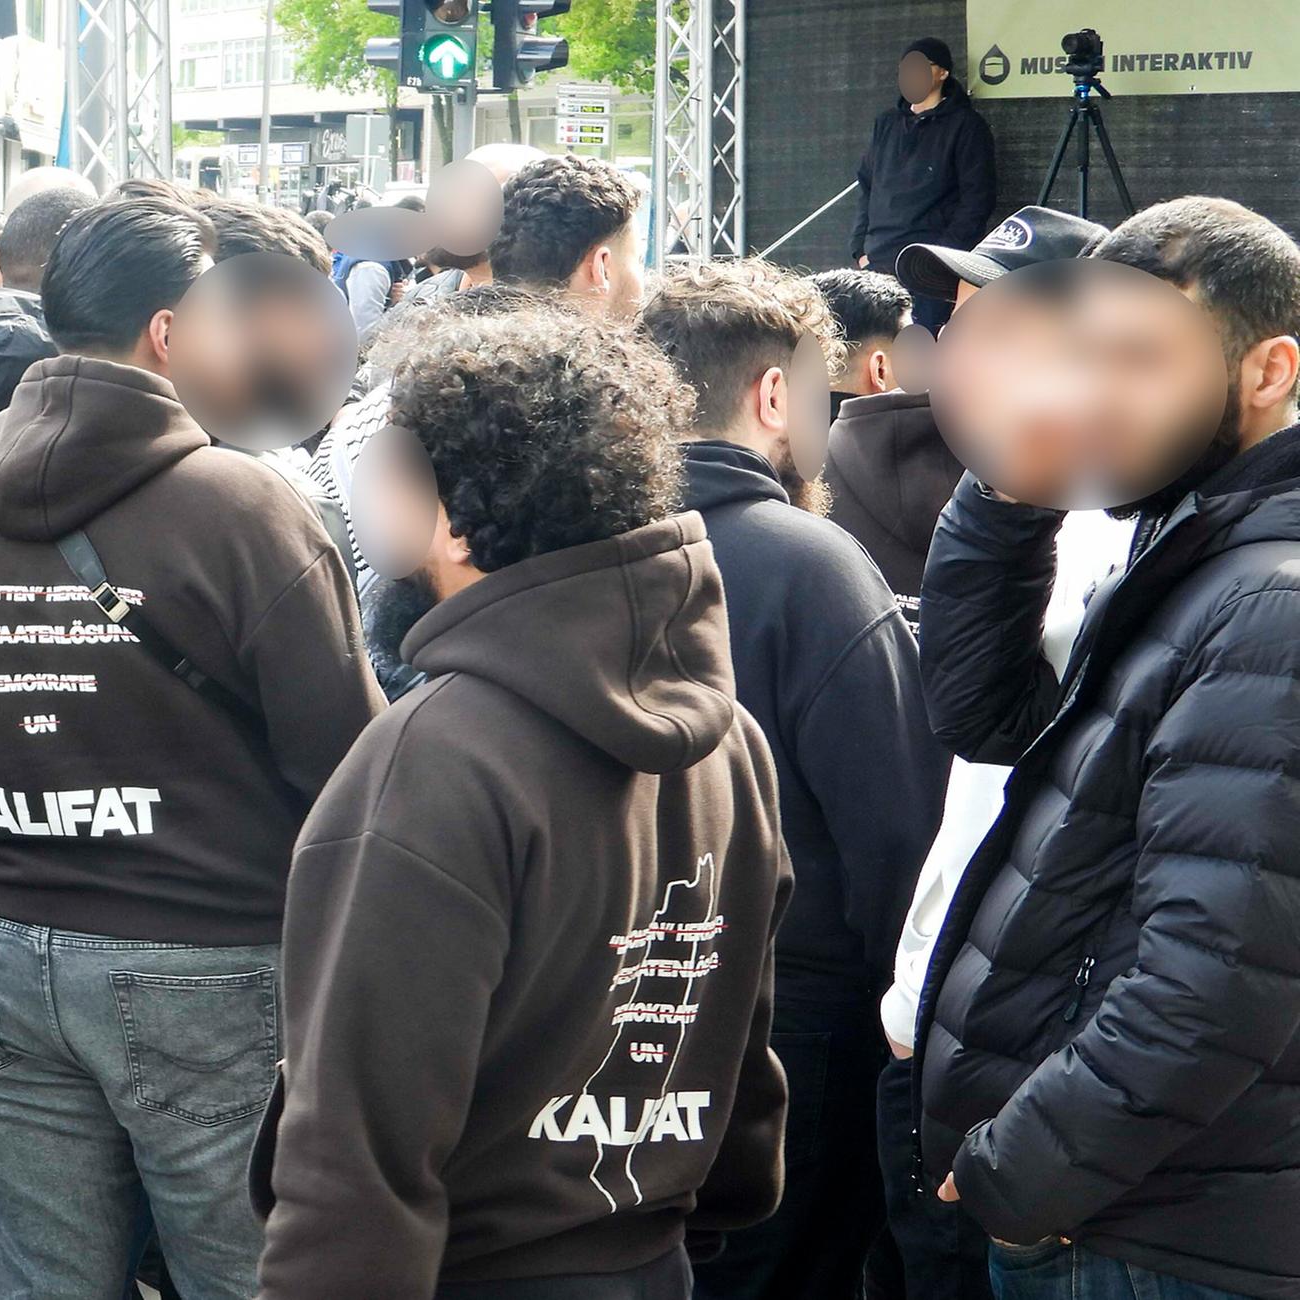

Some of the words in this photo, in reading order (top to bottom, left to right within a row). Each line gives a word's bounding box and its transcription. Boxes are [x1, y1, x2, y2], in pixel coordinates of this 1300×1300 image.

[1112, 51, 1253, 73] INTERAKTIV
[22, 714, 58, 735] UN
[630, 1042, 664, 1063] UN
